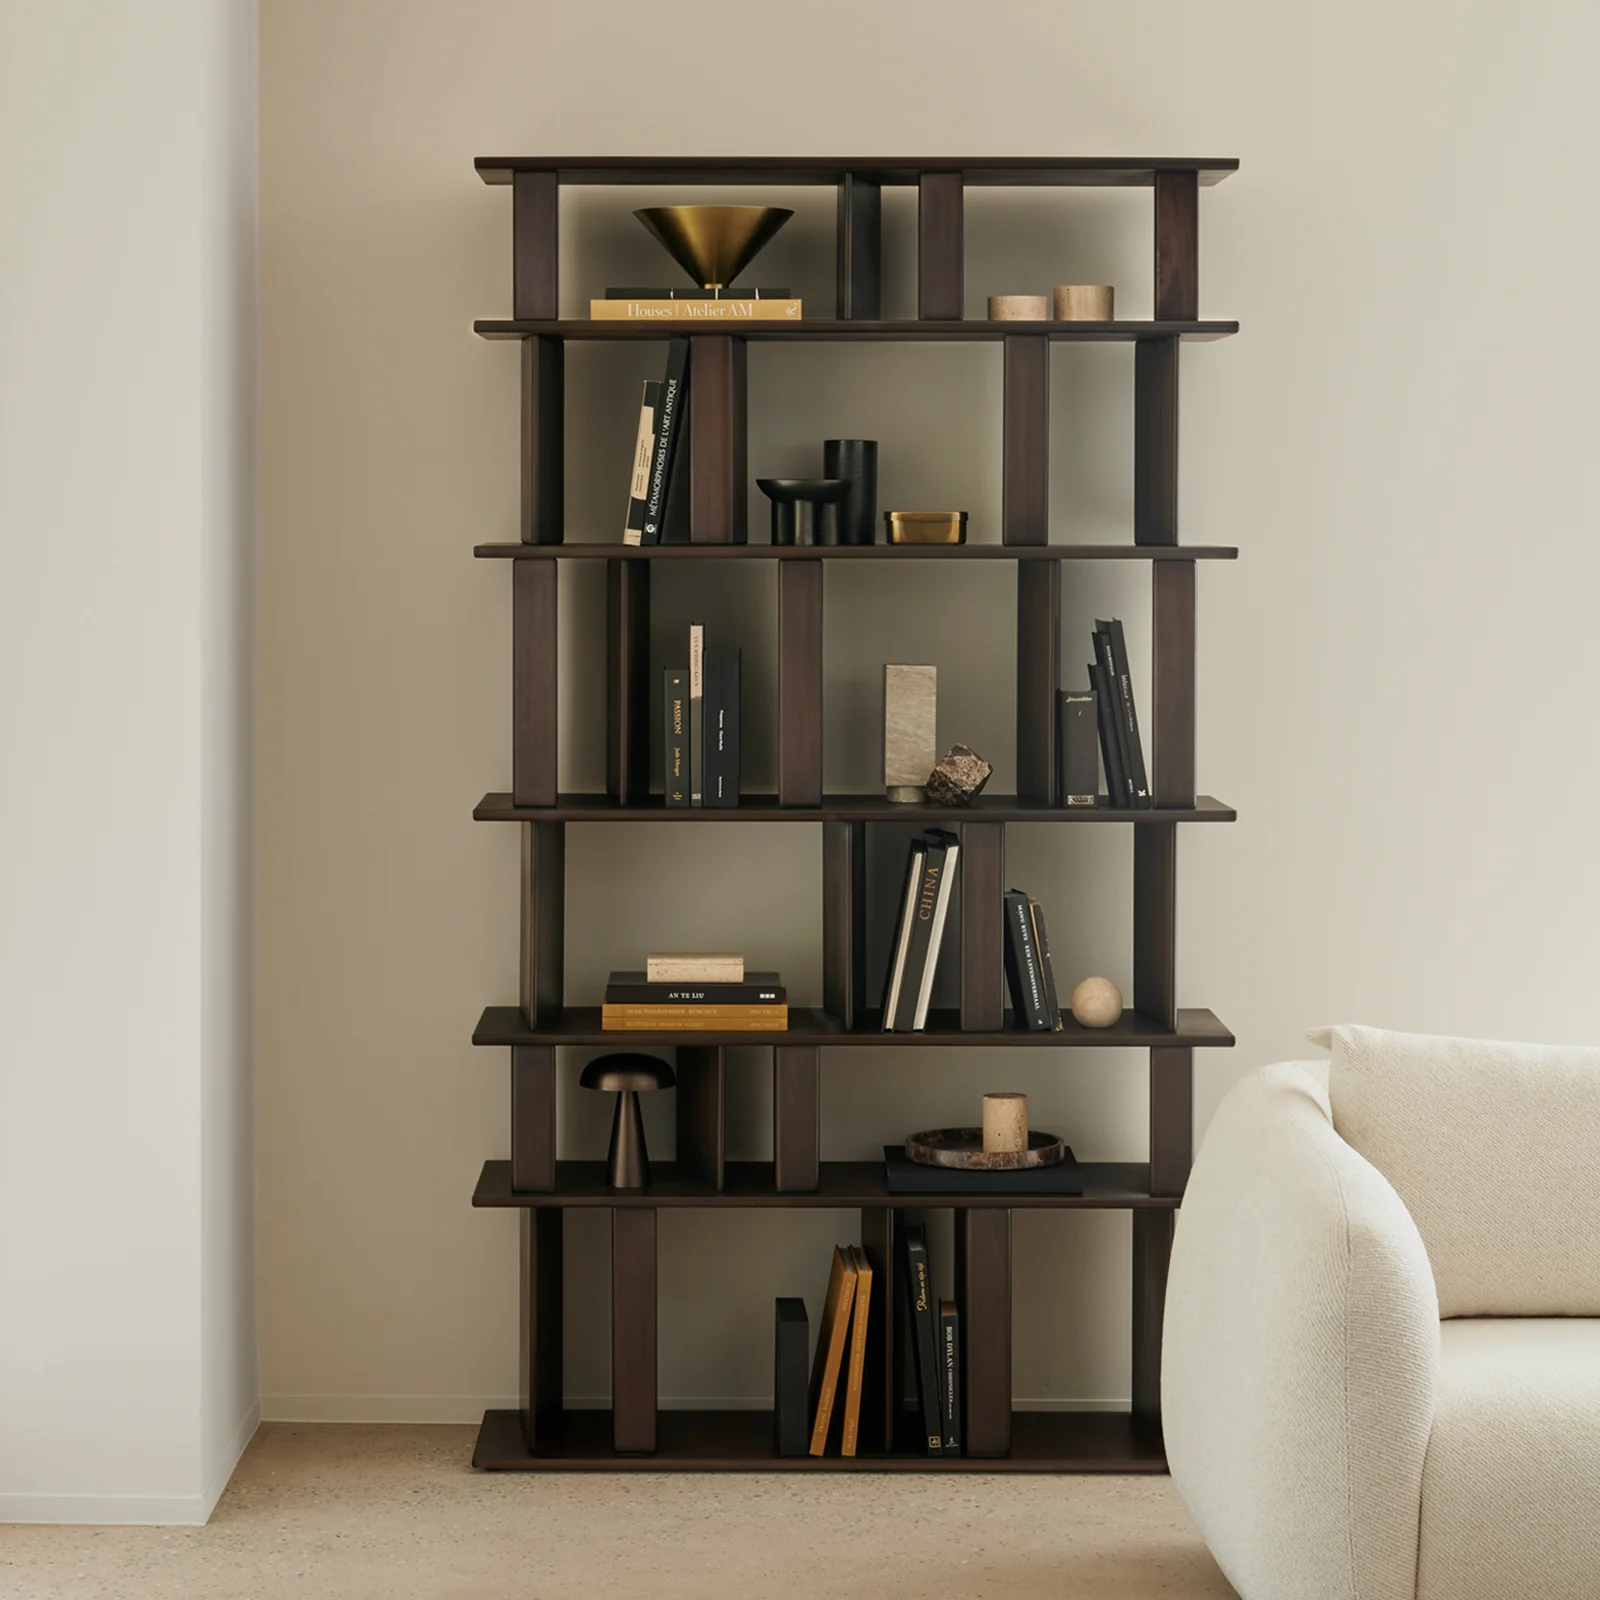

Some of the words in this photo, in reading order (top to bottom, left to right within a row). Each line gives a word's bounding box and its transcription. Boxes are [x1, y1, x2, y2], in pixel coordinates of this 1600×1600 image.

[628, 303, 672, 317] Houses
[683, 303, 725, 317] Atelier
[727, 303, 753, 317] AM
[665, 379, 678, 414] ANTIQUE
[659, 437, 668, 448] DE
[661, 414, 671, 436] L'ART
[649, 448, 667, 516] MÉTAMORPHOSES
[920, 867, 940, 920] CHINA
[1027, 959, 1040, 1010] LEVENSVERHAAL
